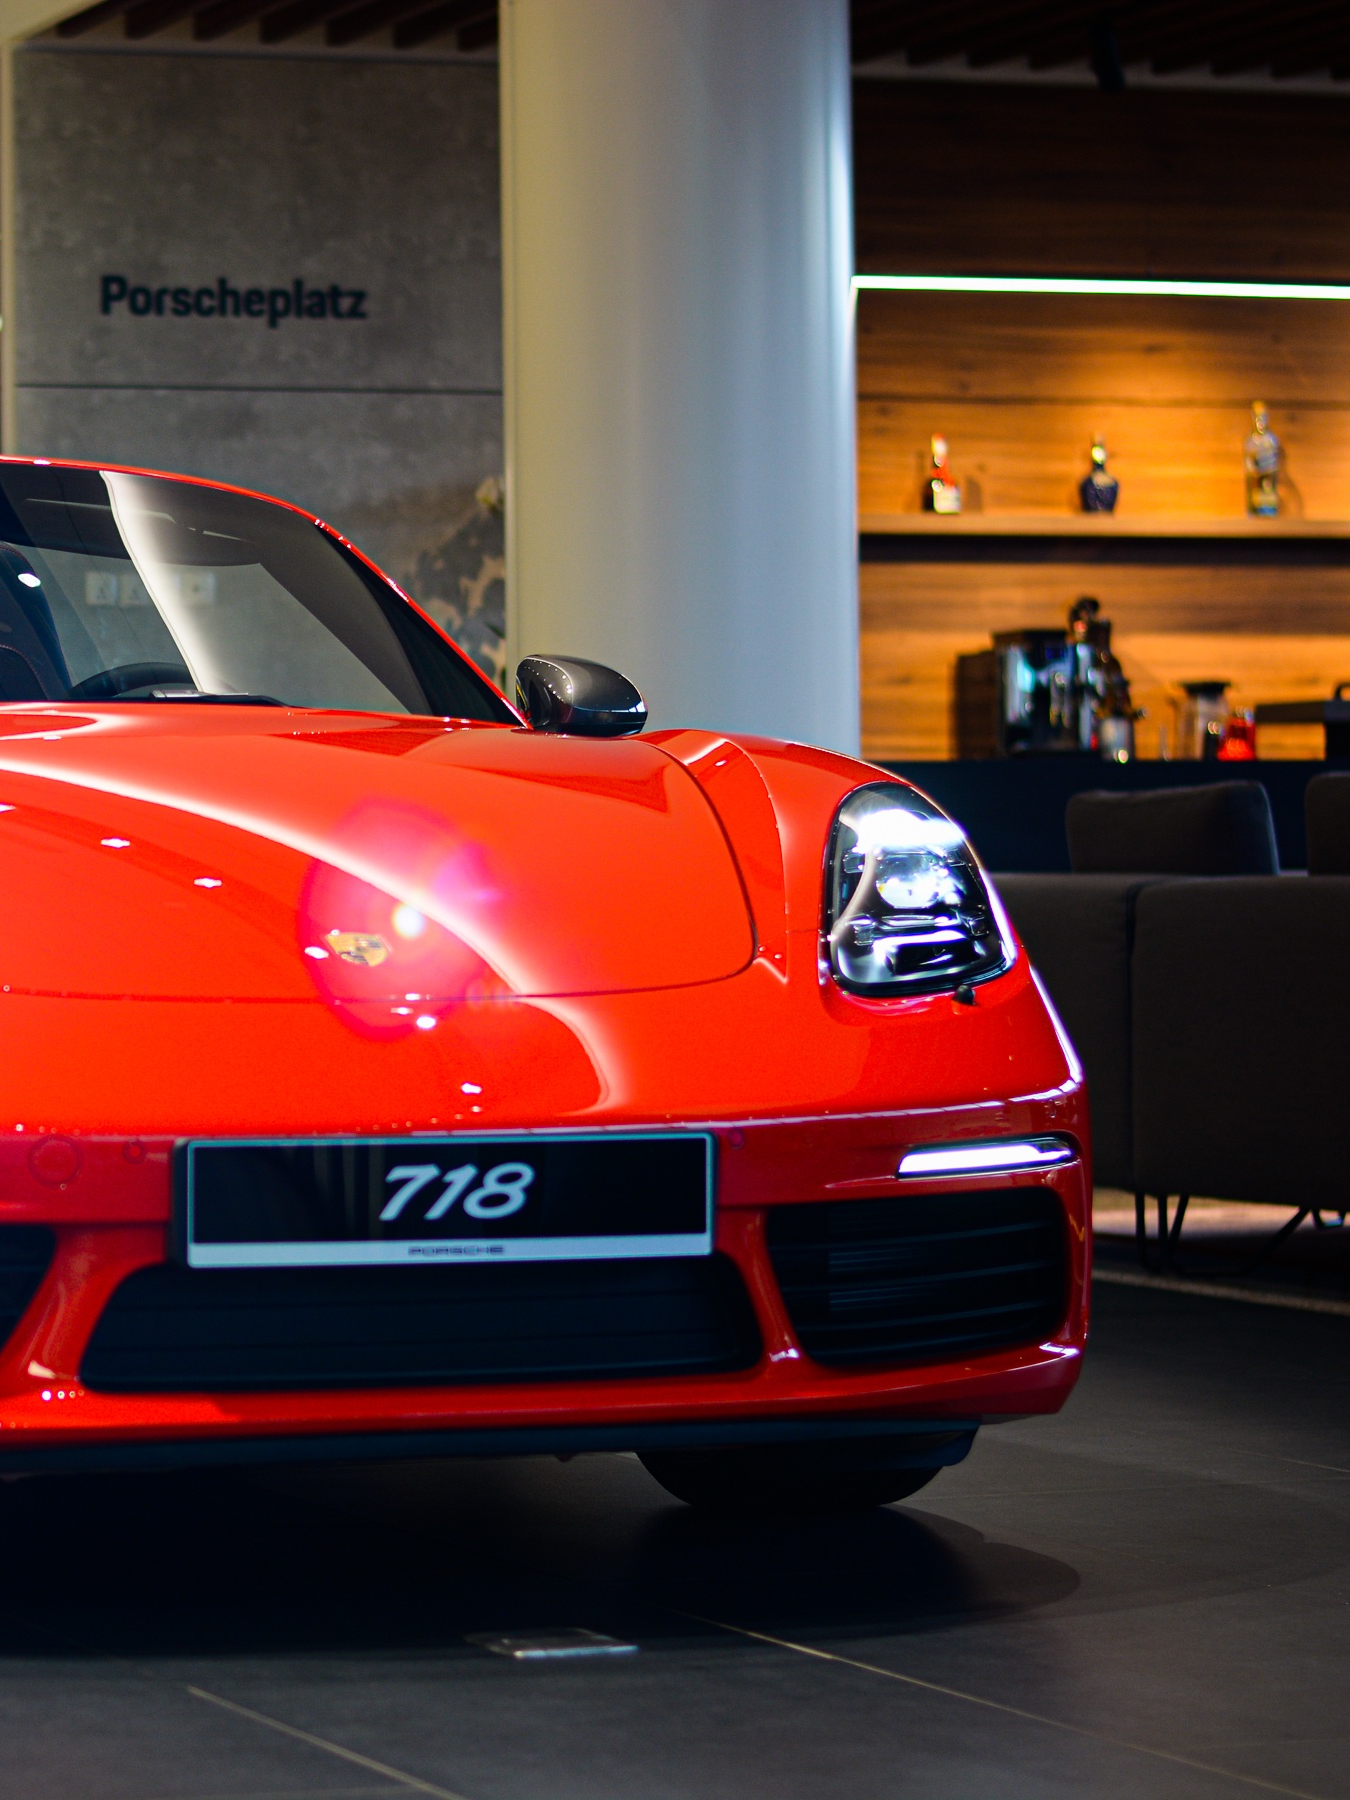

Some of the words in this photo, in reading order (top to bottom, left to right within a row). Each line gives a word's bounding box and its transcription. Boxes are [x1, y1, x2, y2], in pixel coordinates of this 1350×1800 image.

[100, 274, 368, 329] Porscheplatz
[379, 1162, 535, 1221] 718
[408, 1245, 504, 1256] PORSCHE
